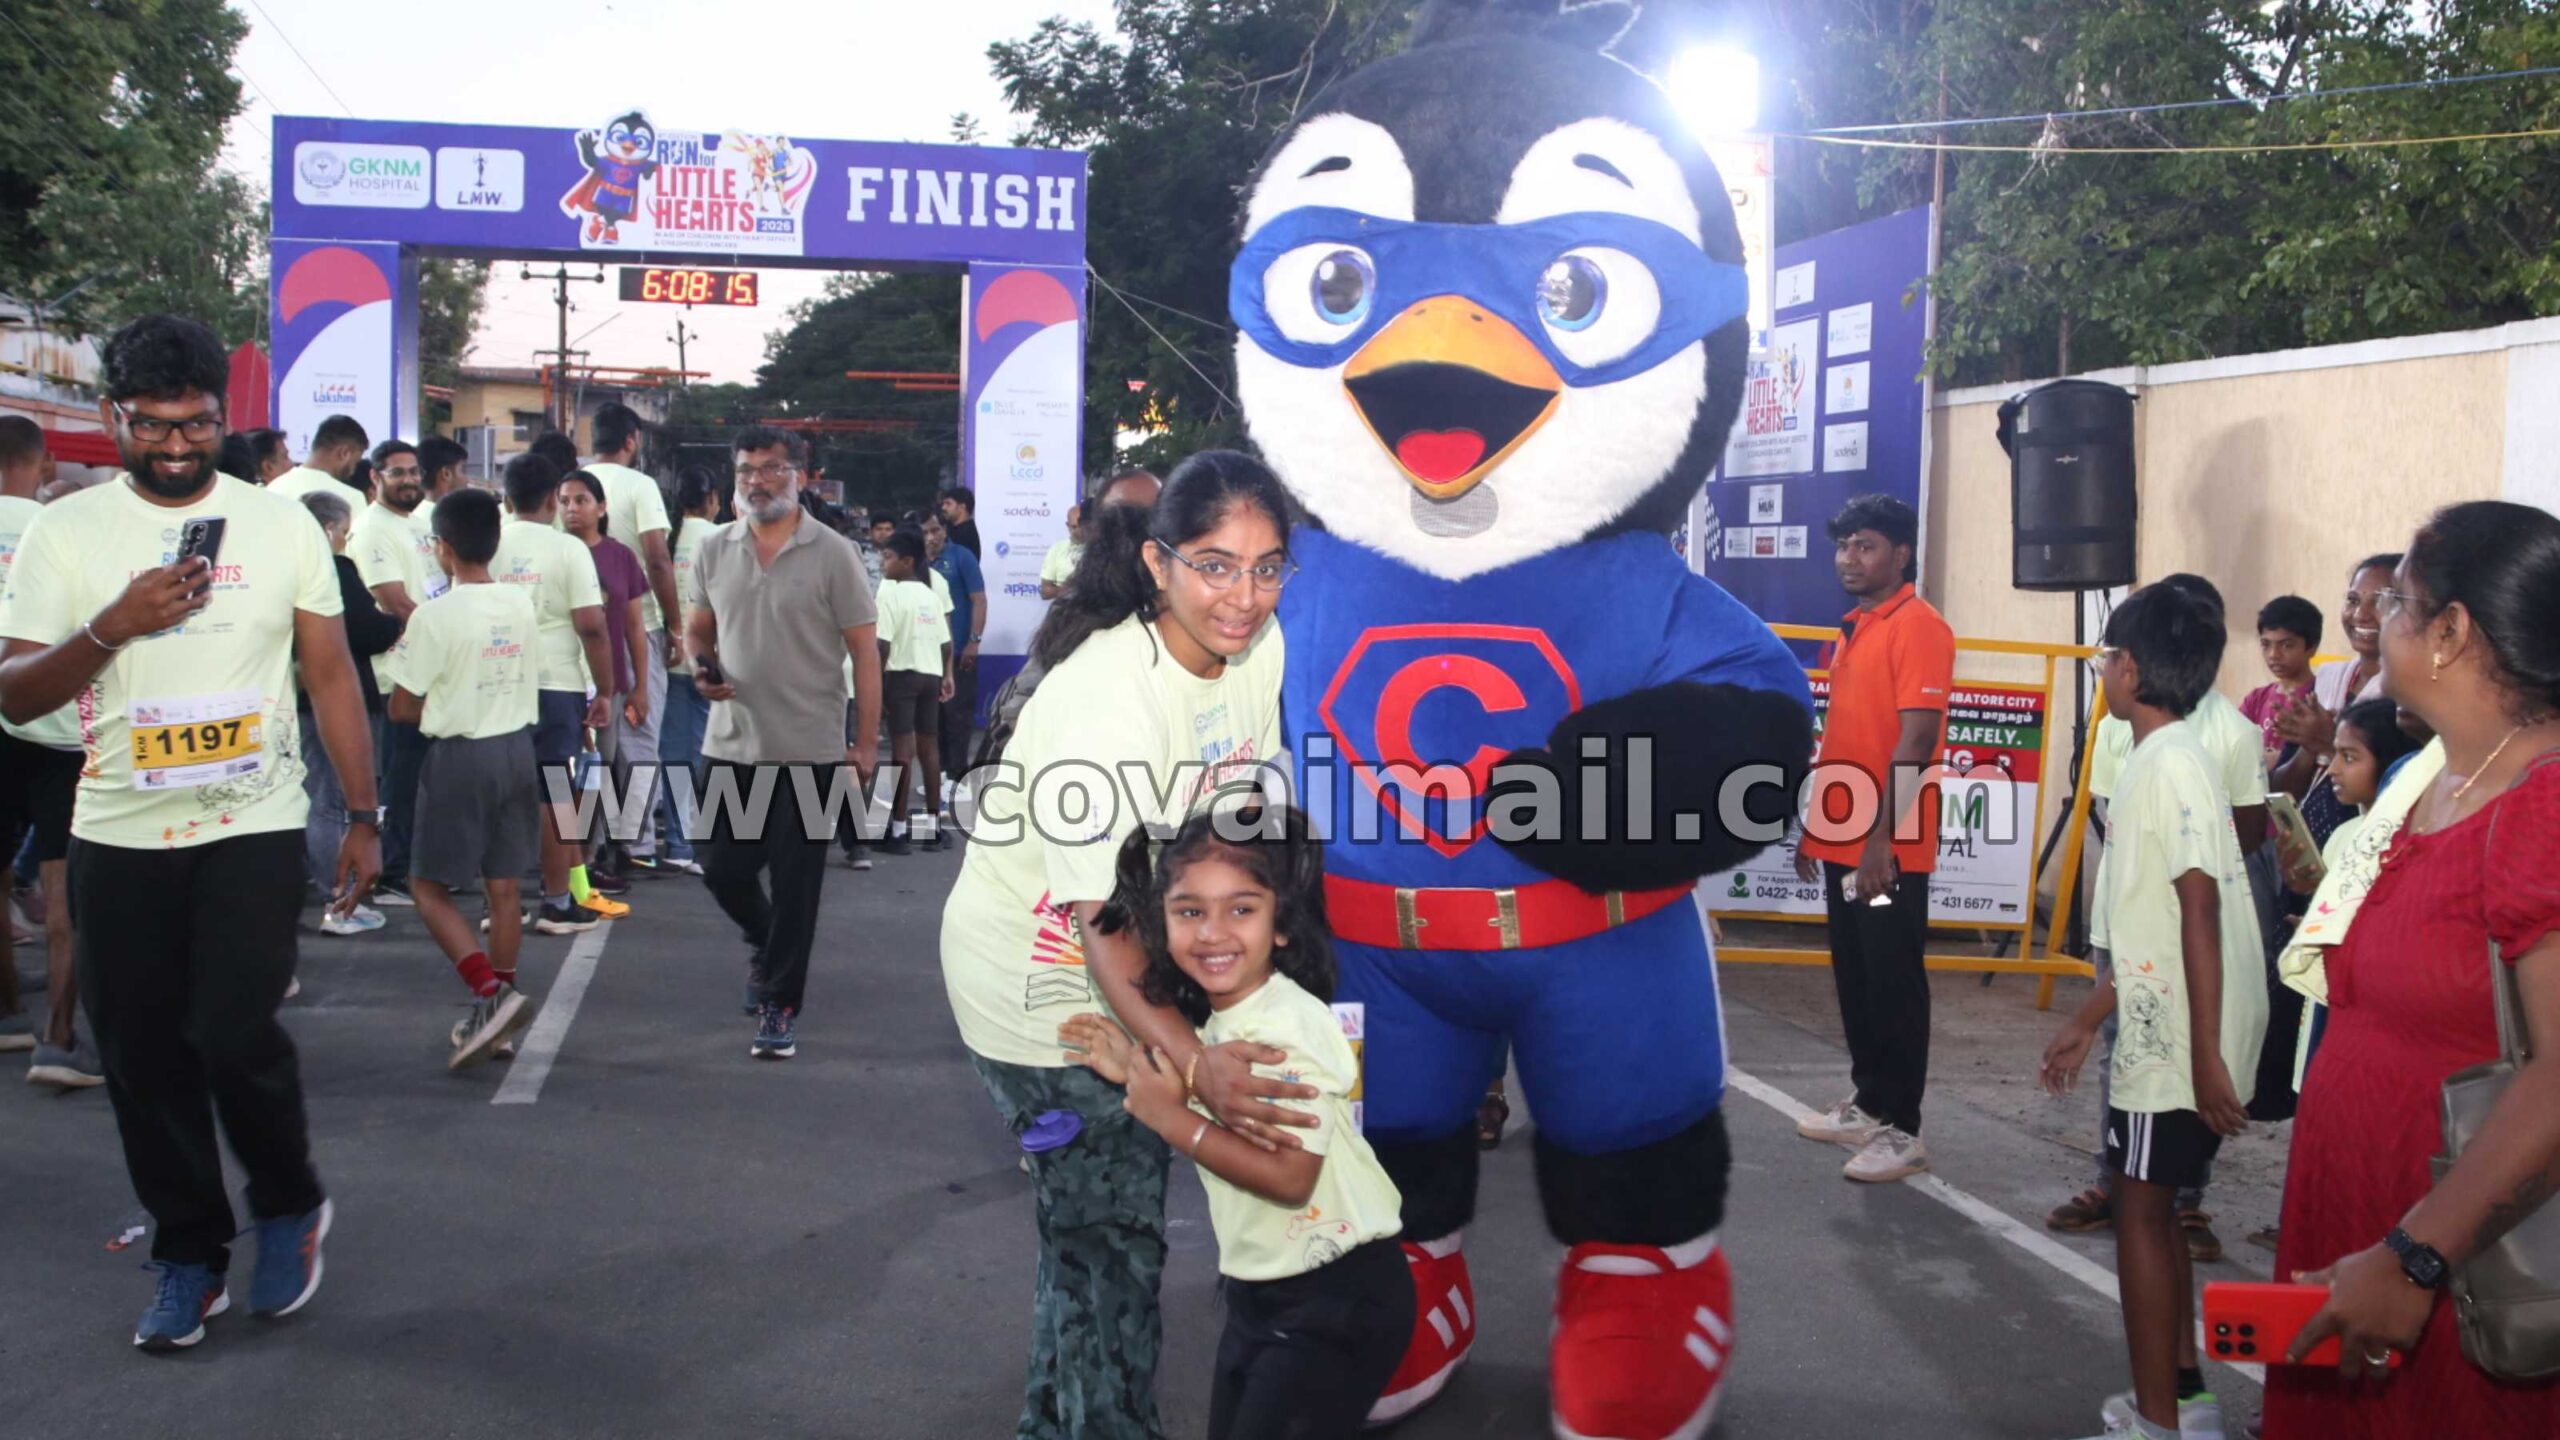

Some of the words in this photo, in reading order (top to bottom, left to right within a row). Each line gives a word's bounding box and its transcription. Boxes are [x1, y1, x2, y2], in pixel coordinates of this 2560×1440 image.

[657, 140, 698, 166] RUN
[349, 158, 421, 176] GKNM
[350, 177, 420, 192] HOSPITAL
[655, 166, 736, 200] LITTLE
[457, 191, 502, 205] LMW
[846, 166, 1076, 232] FINISH
[655, 198, 754, 232] HEARTS
[761, 220, 791, 231] 2026
[1748, 378, 1777, 408] LITTLE
[1746, 405, 1783, 435] HEARTS
[1003, 502, 1050, 518] sodexo
[2006, 696, 2037, 708] CITY
[156, 720, 242, 755] 1197
[1946, 724, 2022, 745] SAFELY.
[1756, 885, 1819, 901] 0422-430
[1964, 898, 1994, 910] 6677
